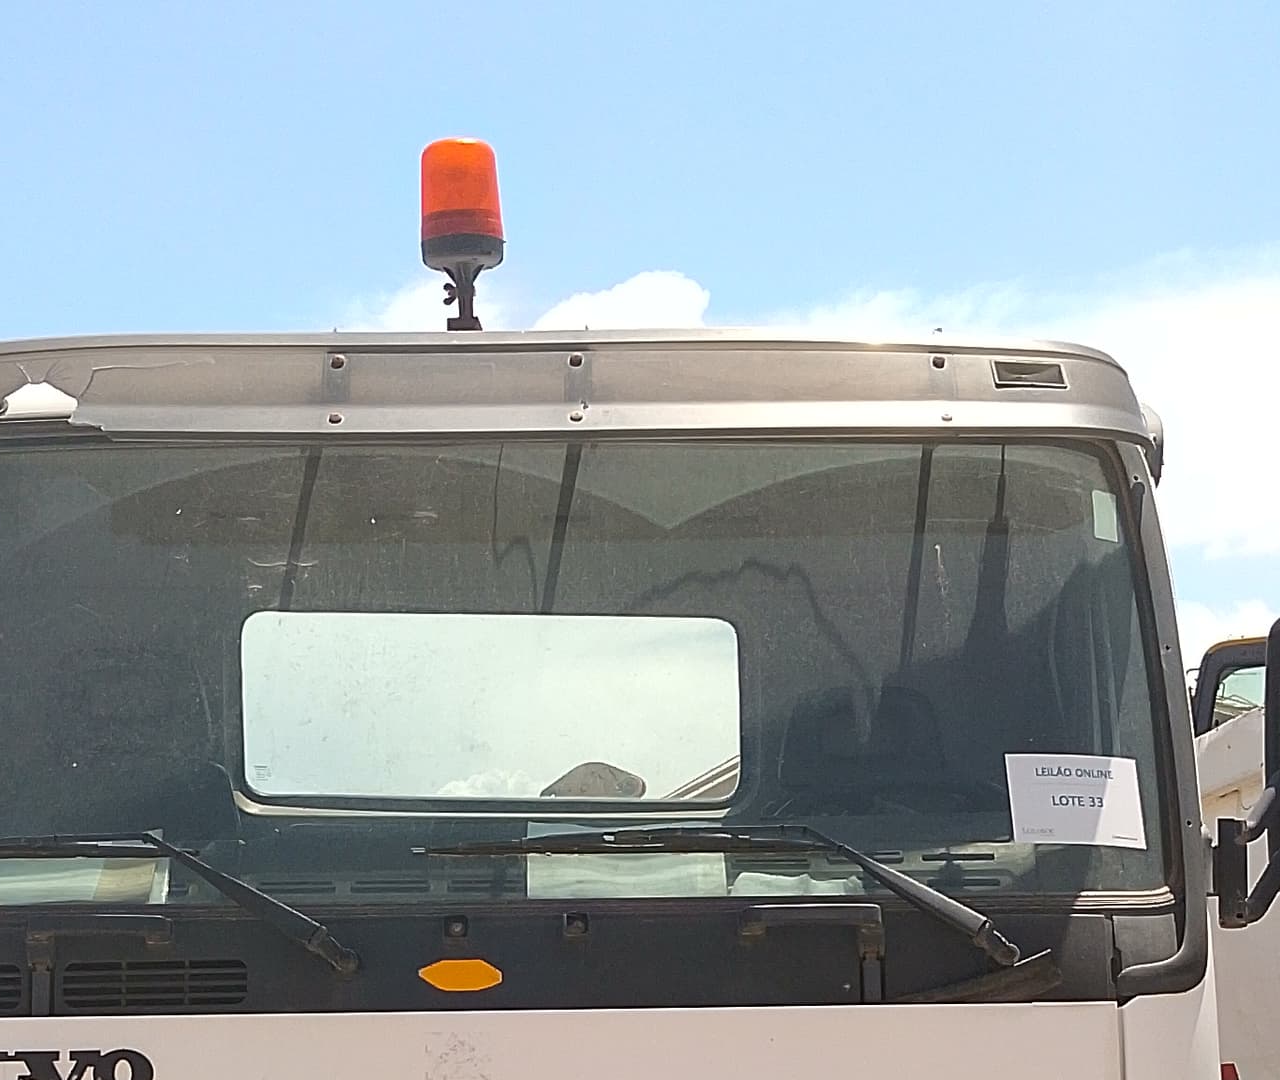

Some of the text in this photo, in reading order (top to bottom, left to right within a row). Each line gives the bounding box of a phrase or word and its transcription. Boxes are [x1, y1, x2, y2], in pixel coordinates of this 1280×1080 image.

[1035, 766, 1114, 780] LEILÃO ONLINE
[1051, 795, 1104, 807] LOTE 33
